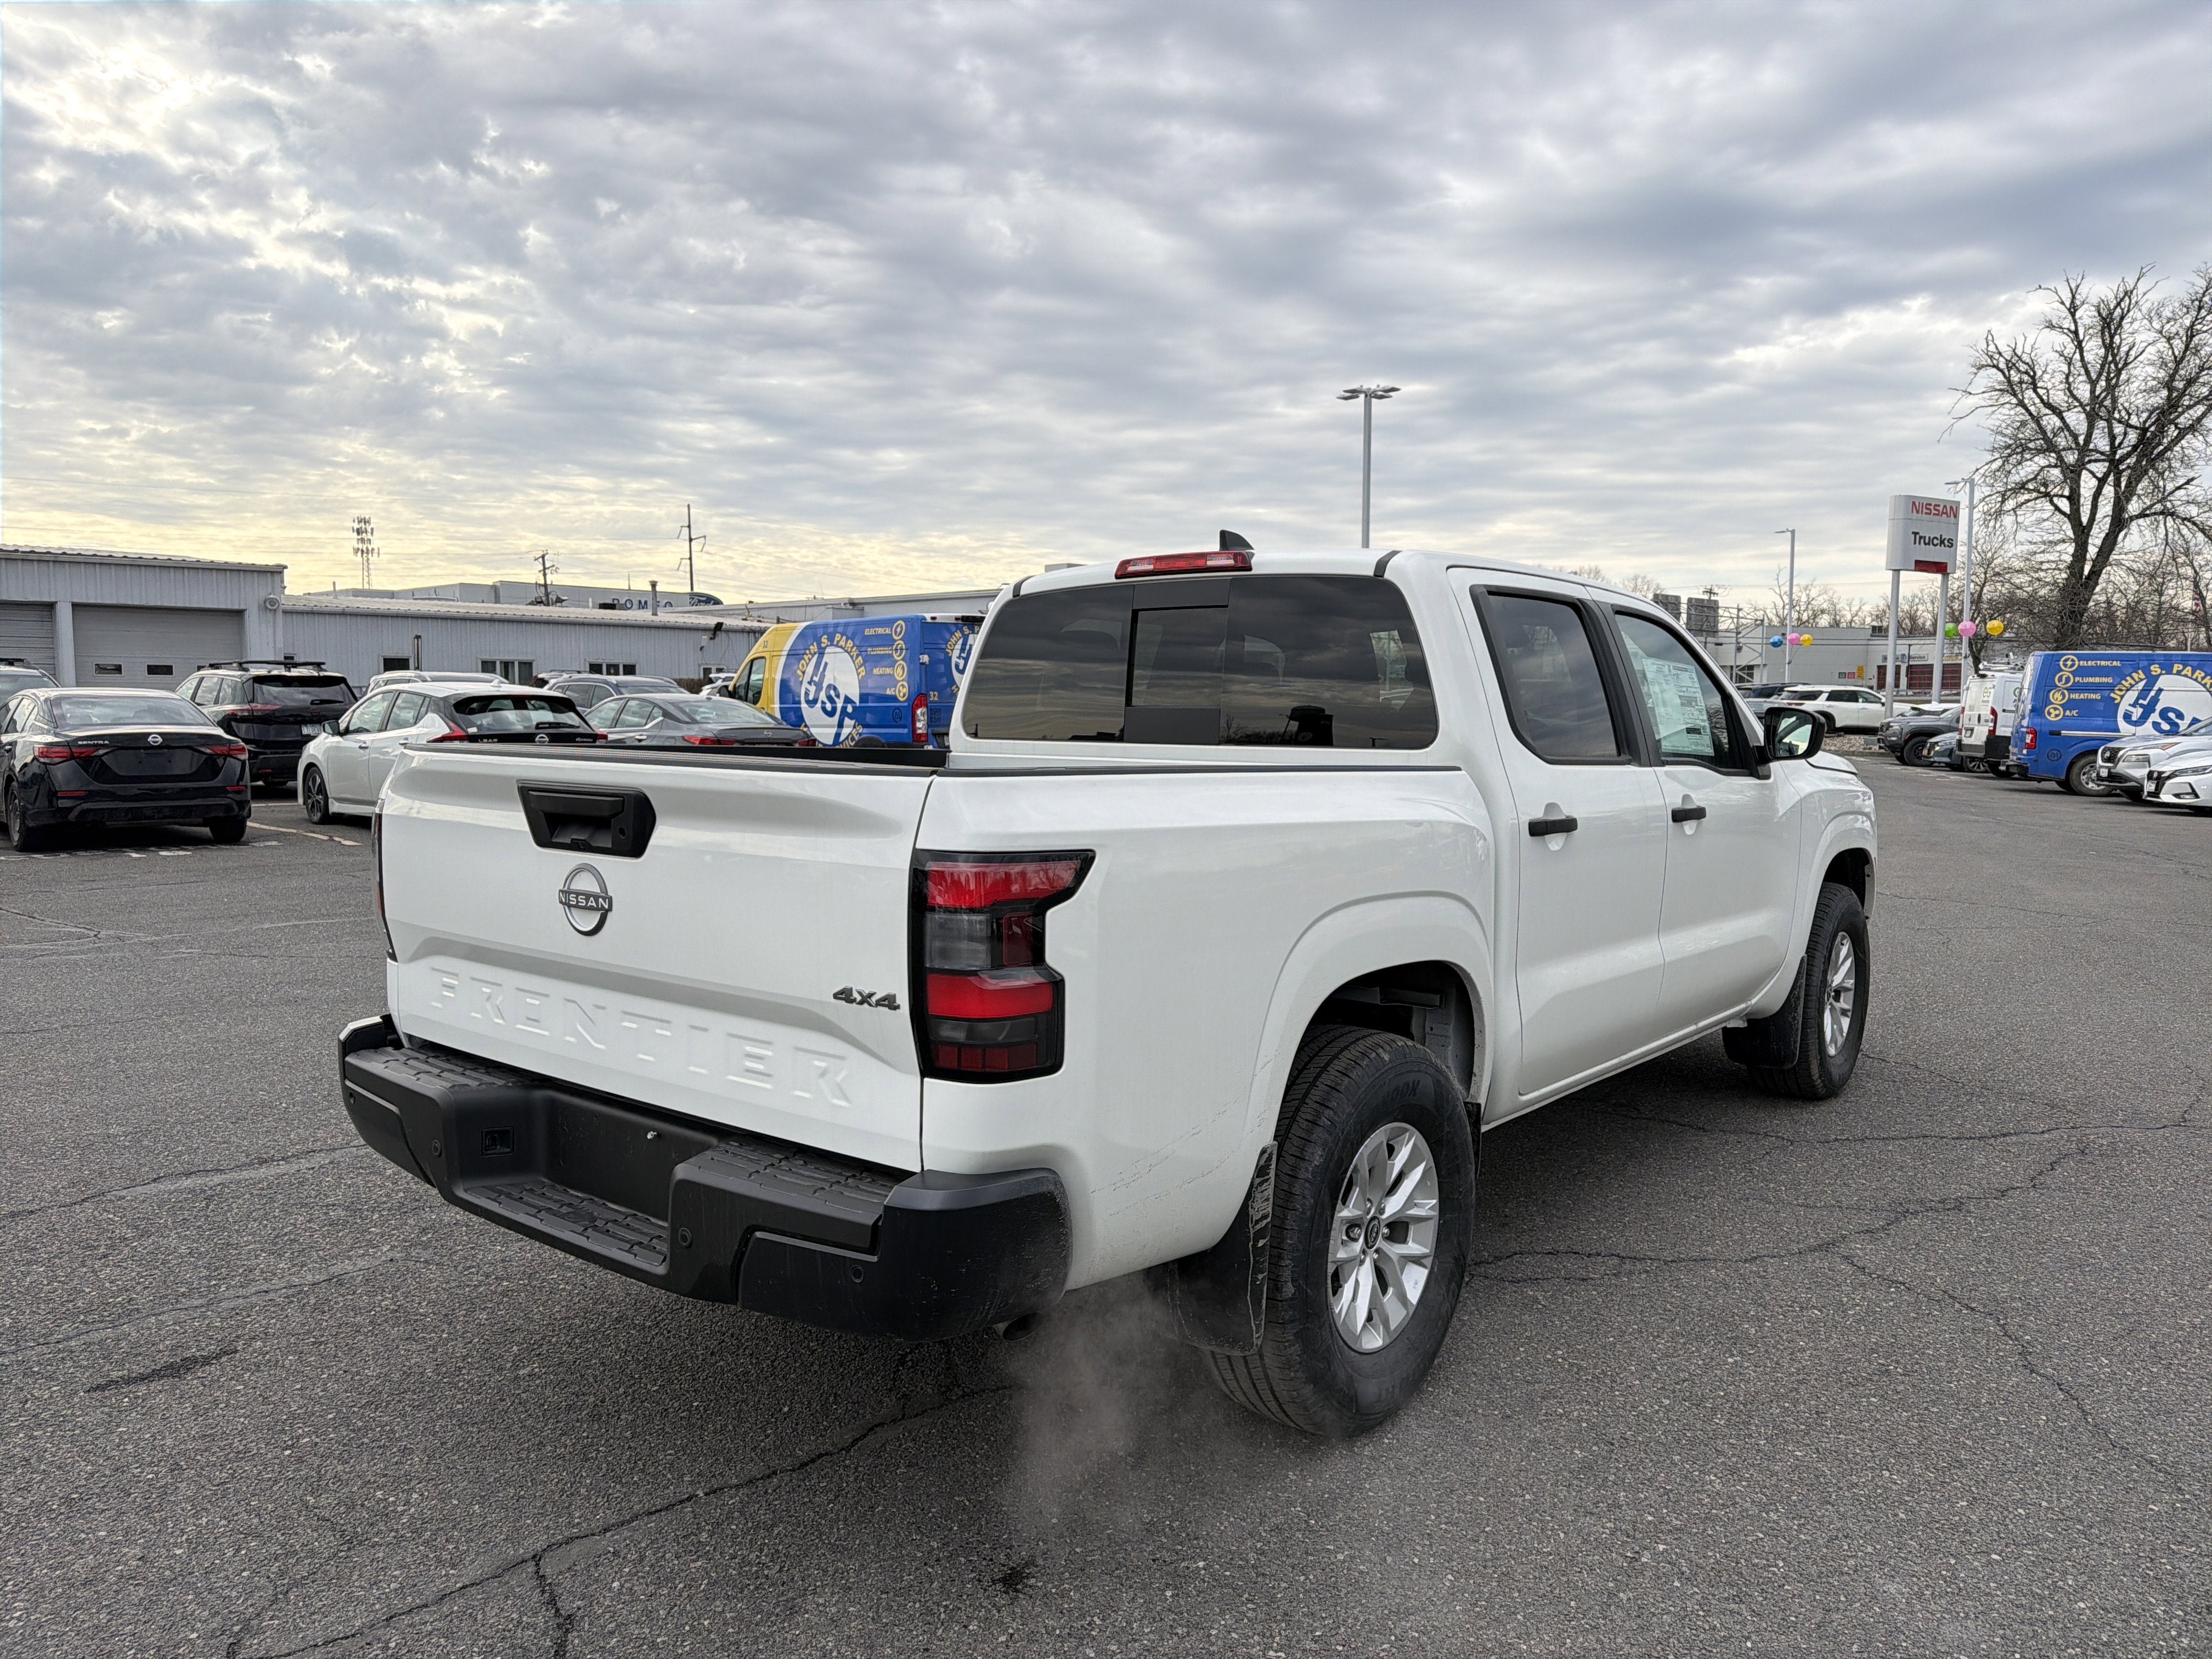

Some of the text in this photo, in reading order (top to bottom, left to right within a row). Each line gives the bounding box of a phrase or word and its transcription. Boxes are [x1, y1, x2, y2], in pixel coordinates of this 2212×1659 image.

[1911, 500, 1958, 518] NISSAN
[1911, 531, 1954, 548] Trucks
[864, 627, 891, 635] ELECTRICAL
[946, 629, 963, 657] JOHN
[963, 625, 972, 635] S.
[797, 633, 866, 681] JOHN S. PARKER
[2109, 669, 2146, 704] JOHN
[2150, 663, 2166, 676] S.
[929, 691, 939, 701] 32
[559, 891, 609, 909] NISSAN
